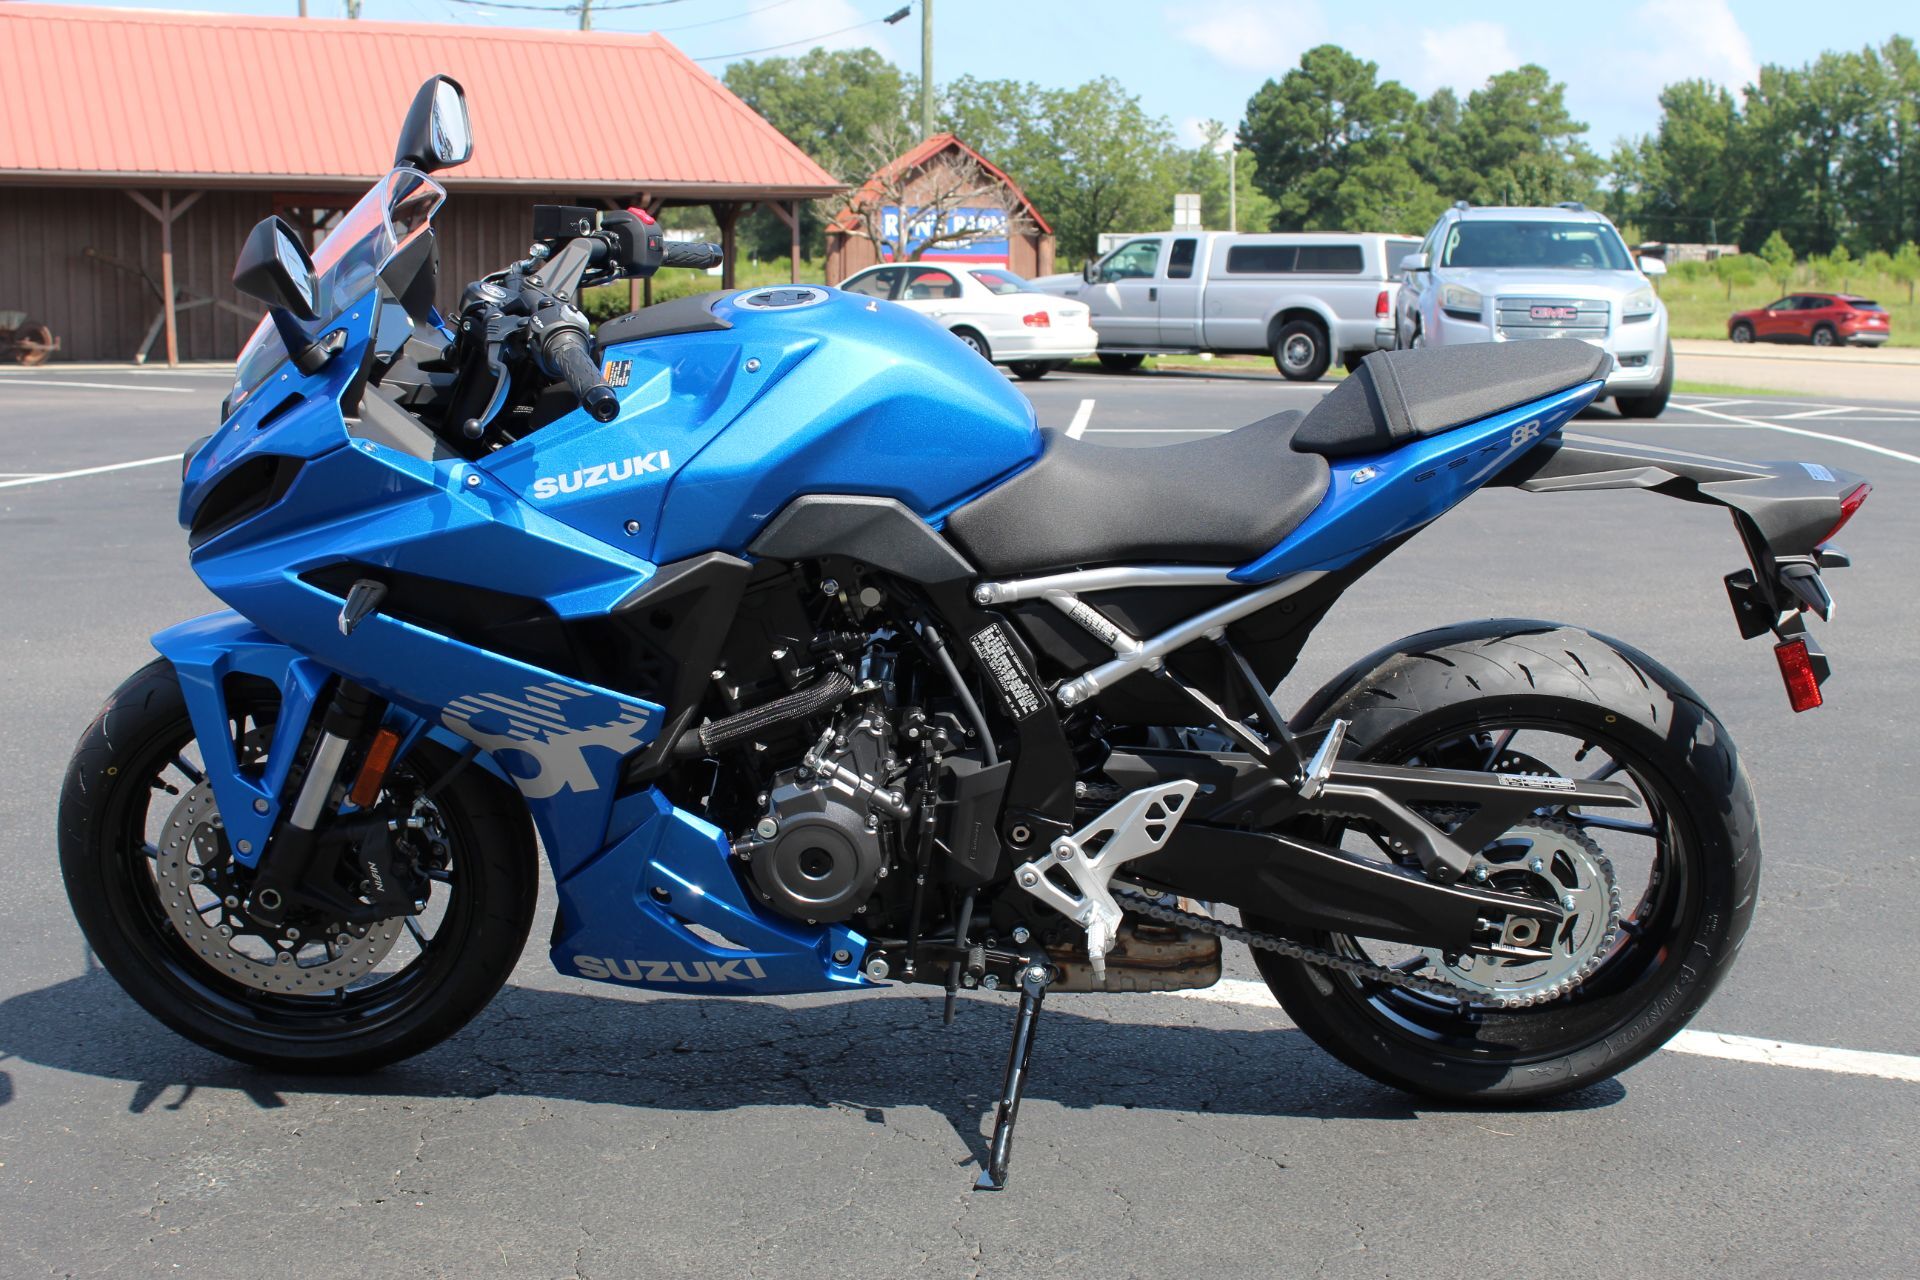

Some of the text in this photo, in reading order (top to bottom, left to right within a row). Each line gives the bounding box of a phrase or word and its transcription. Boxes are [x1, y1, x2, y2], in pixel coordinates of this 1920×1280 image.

[1531, 306, 1577, 319] GMC
[1510, 419, 1540, 447] 8R
[533, 449, 671, 499] SUZUKI
[573, 955, 767, 982] SUZUKI
